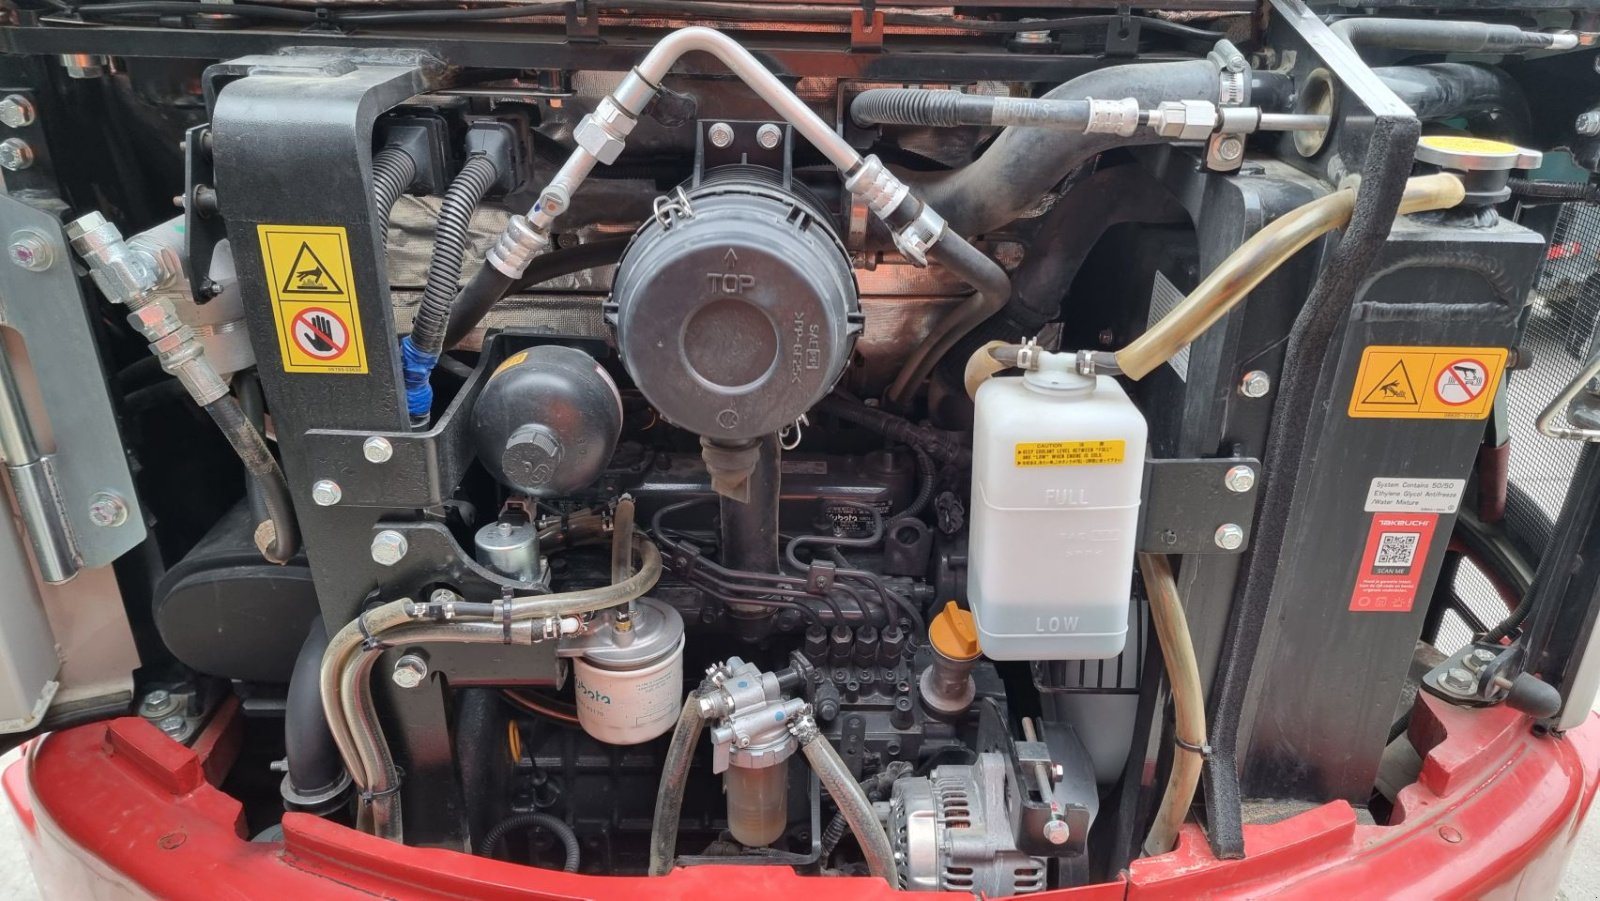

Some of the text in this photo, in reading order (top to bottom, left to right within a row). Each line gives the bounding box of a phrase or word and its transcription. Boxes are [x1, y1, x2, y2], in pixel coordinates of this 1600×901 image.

[706, 272, 755, 293] TOP
[1376, 481, 1399, 489] System
[1045, 488, 1089, 505] FULL
[1035, 616, 1080, 632] LOW
[574, 674, 611, 705] ubota
